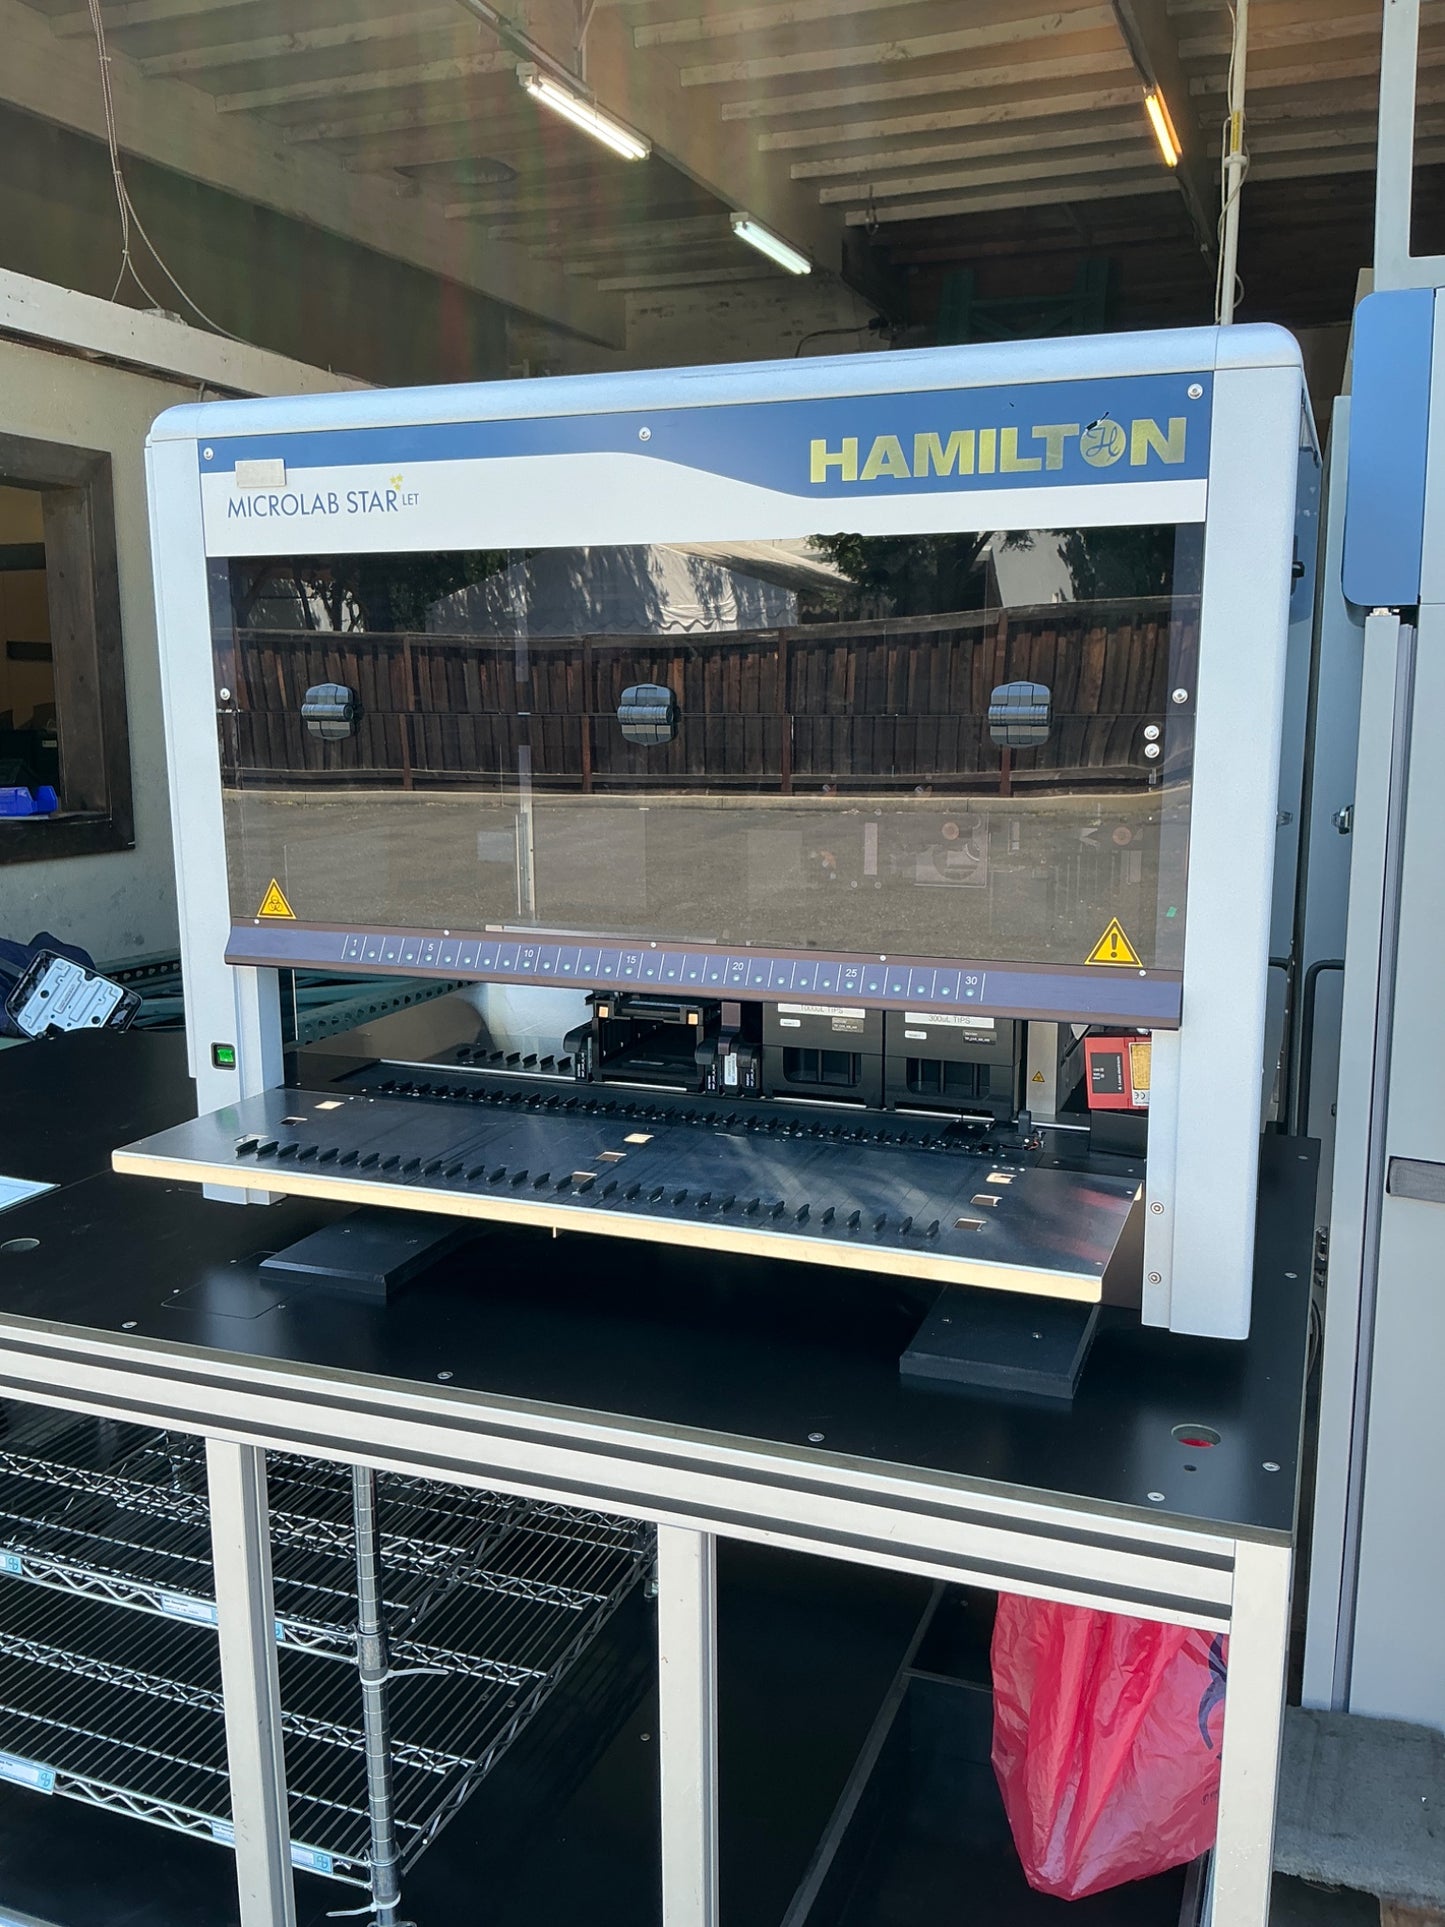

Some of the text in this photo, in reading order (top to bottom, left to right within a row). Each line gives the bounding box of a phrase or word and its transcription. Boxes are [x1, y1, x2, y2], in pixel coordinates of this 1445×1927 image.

[809, 416, 1188, 484] HAMILTON
[227, 492, 339, 518] MICROLAB
[352, 938, 978, 986] 1 5 10 15 20 25 30
[953, 1016, 971, 1024] TIPS
